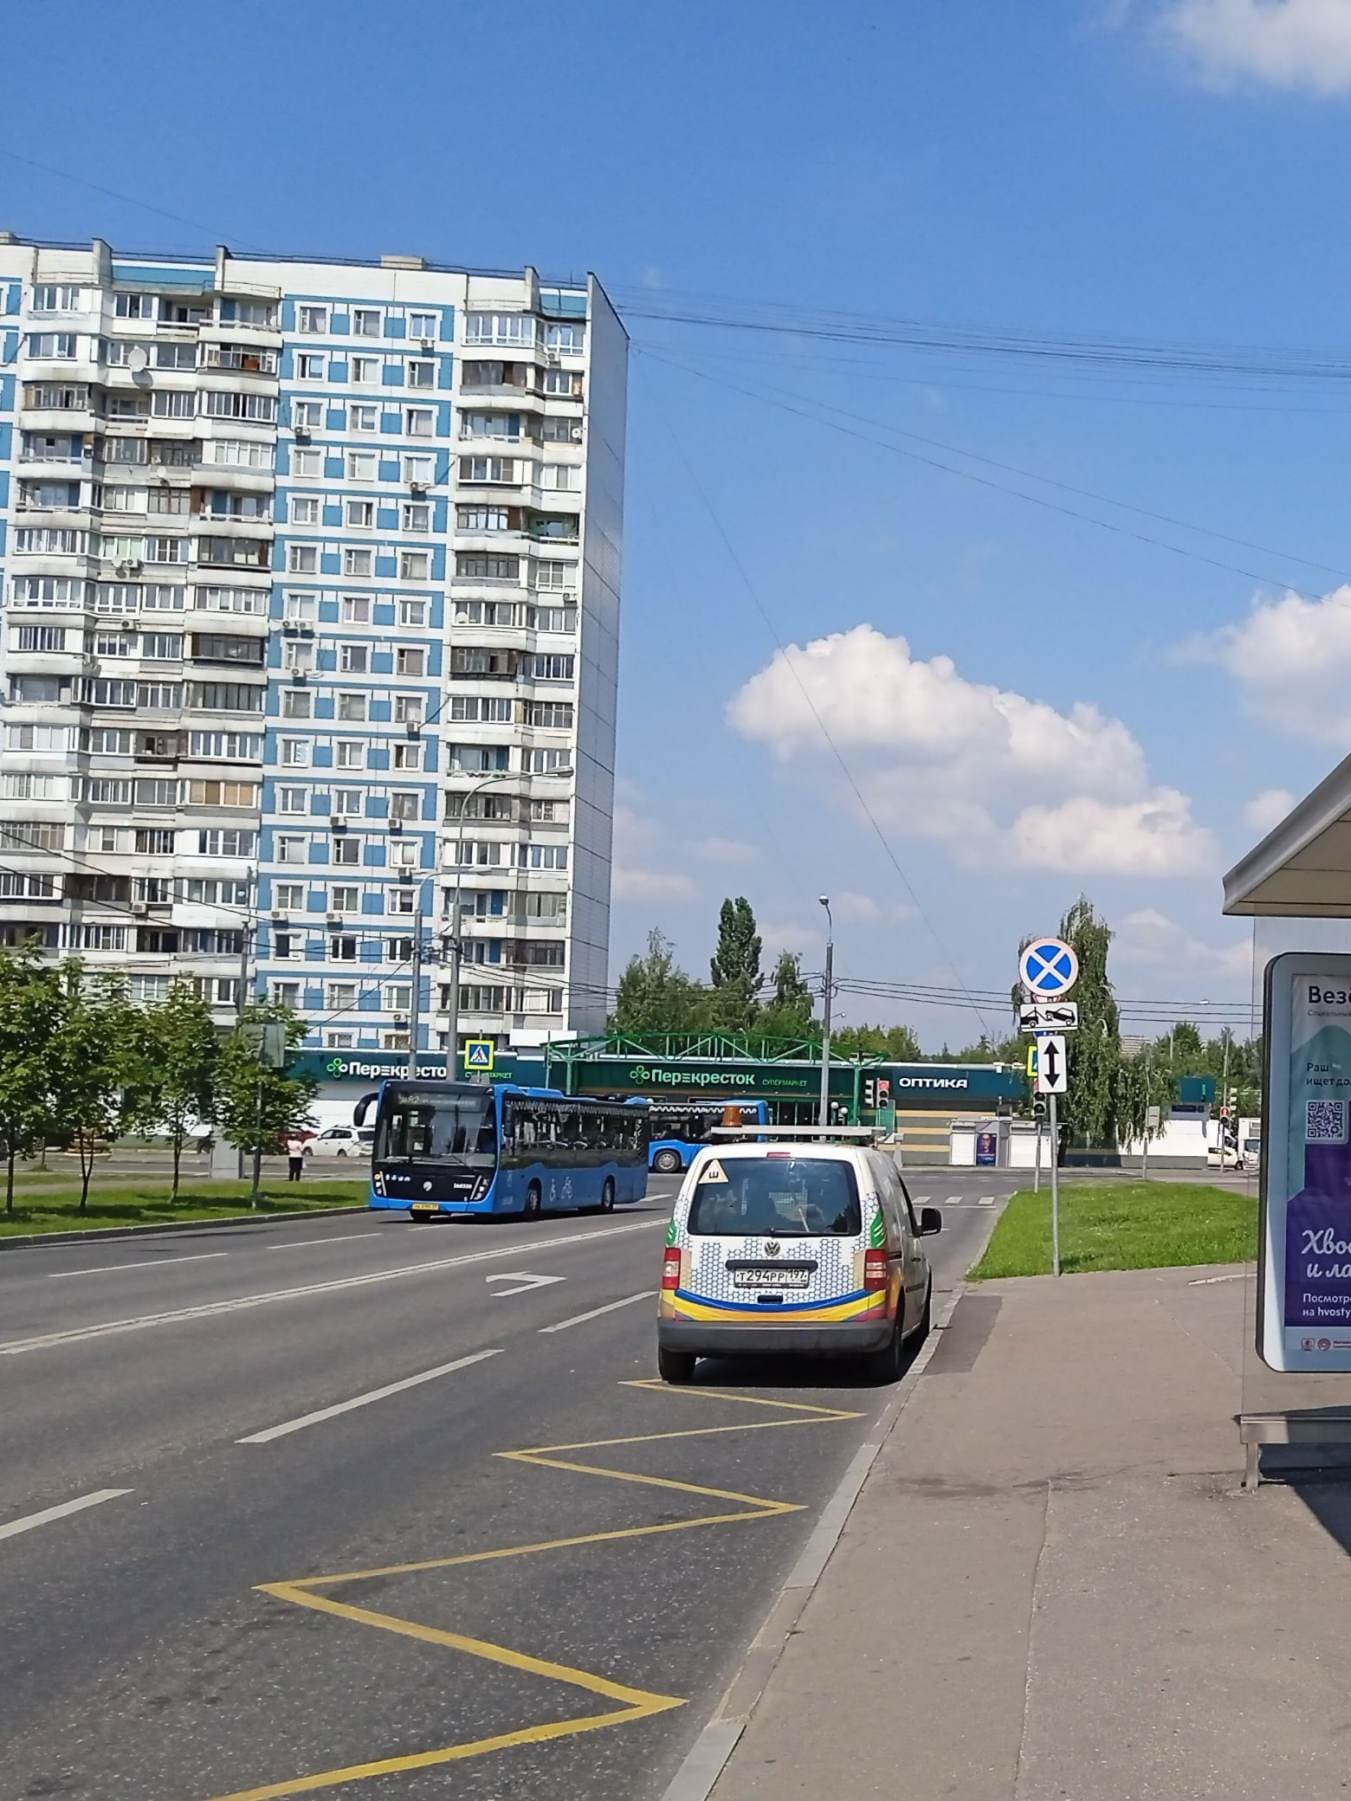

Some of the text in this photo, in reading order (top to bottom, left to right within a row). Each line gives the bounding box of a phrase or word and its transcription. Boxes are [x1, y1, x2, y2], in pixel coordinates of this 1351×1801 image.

[349, 1061, 448, 1080] Перекрсто
[1306, 1062, 1329, 1072] Раш
[651, 1068, 756, 1087] Перекресток
[899, 1077, 968, 1089] ОПТИКА
[1306, 1078, 1335, 1087] ищет
[708, 1171, 719, 1179] Ш
[1306, 1263, 1323, 1278] и
[1302, 1308, 1315, 1316] на
